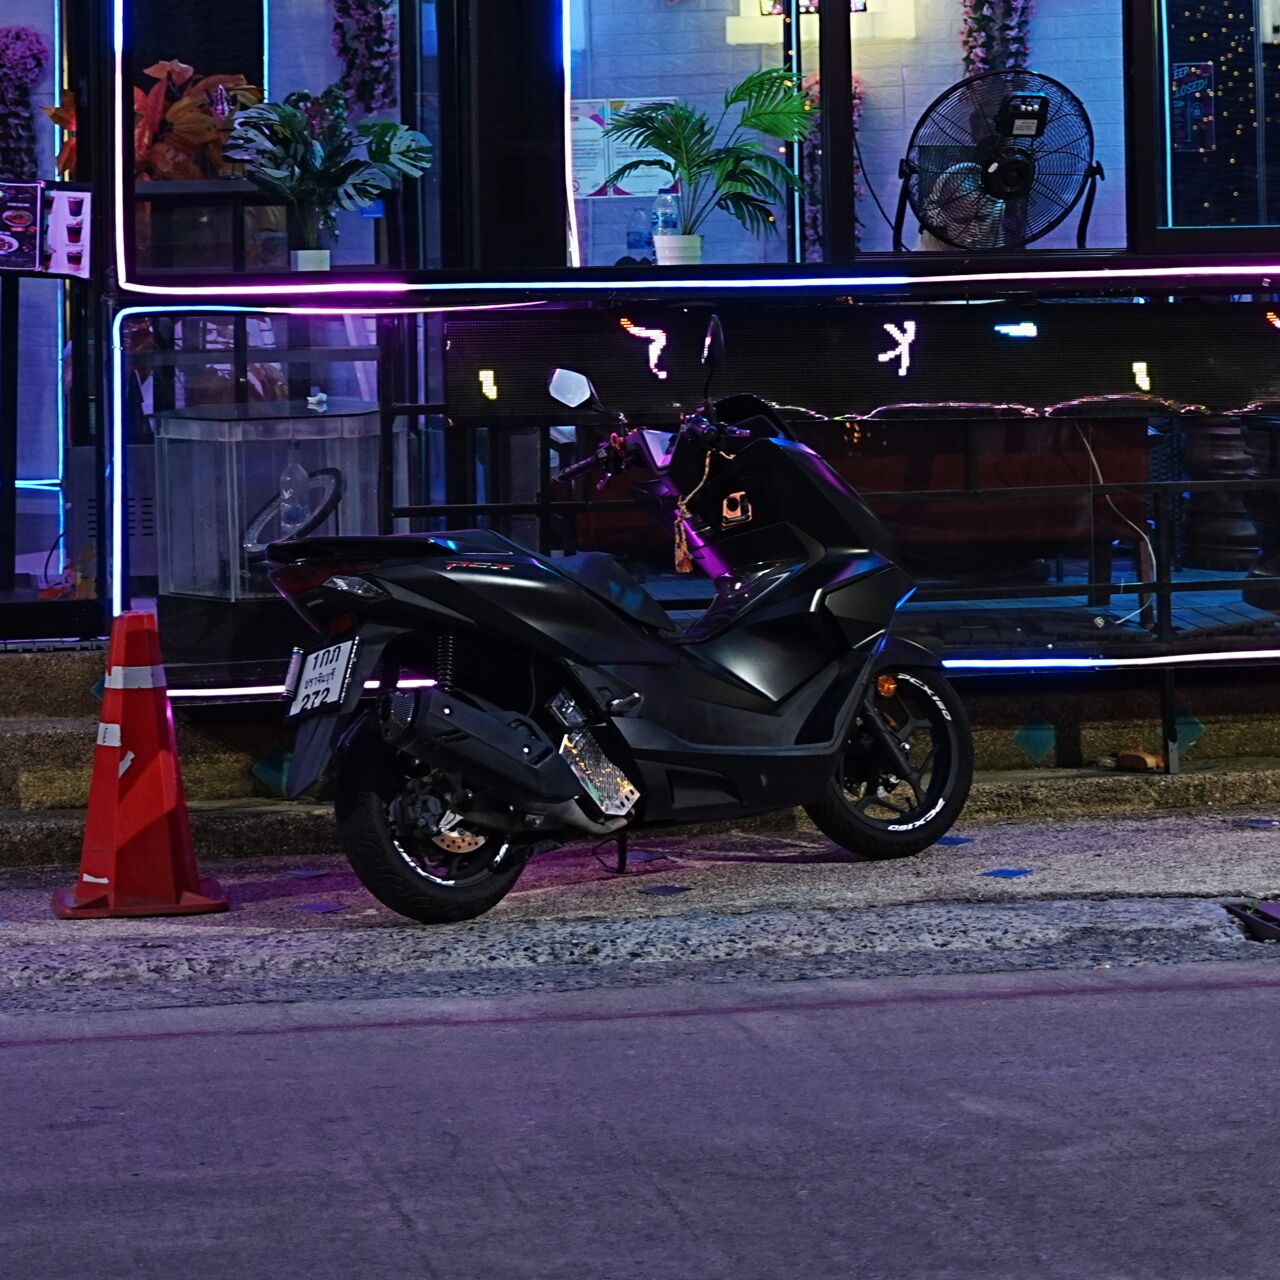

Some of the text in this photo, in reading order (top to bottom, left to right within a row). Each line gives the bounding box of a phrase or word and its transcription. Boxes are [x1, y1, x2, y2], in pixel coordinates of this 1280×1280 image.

[1173, 66, 1190, 80] EEP
[1173, 77, 1209, 98] LOSED!
[300, 686, 331, 711] 272
[896, 671, 954, 722] PCX160
[886, 796, 947, 832] PCX160
